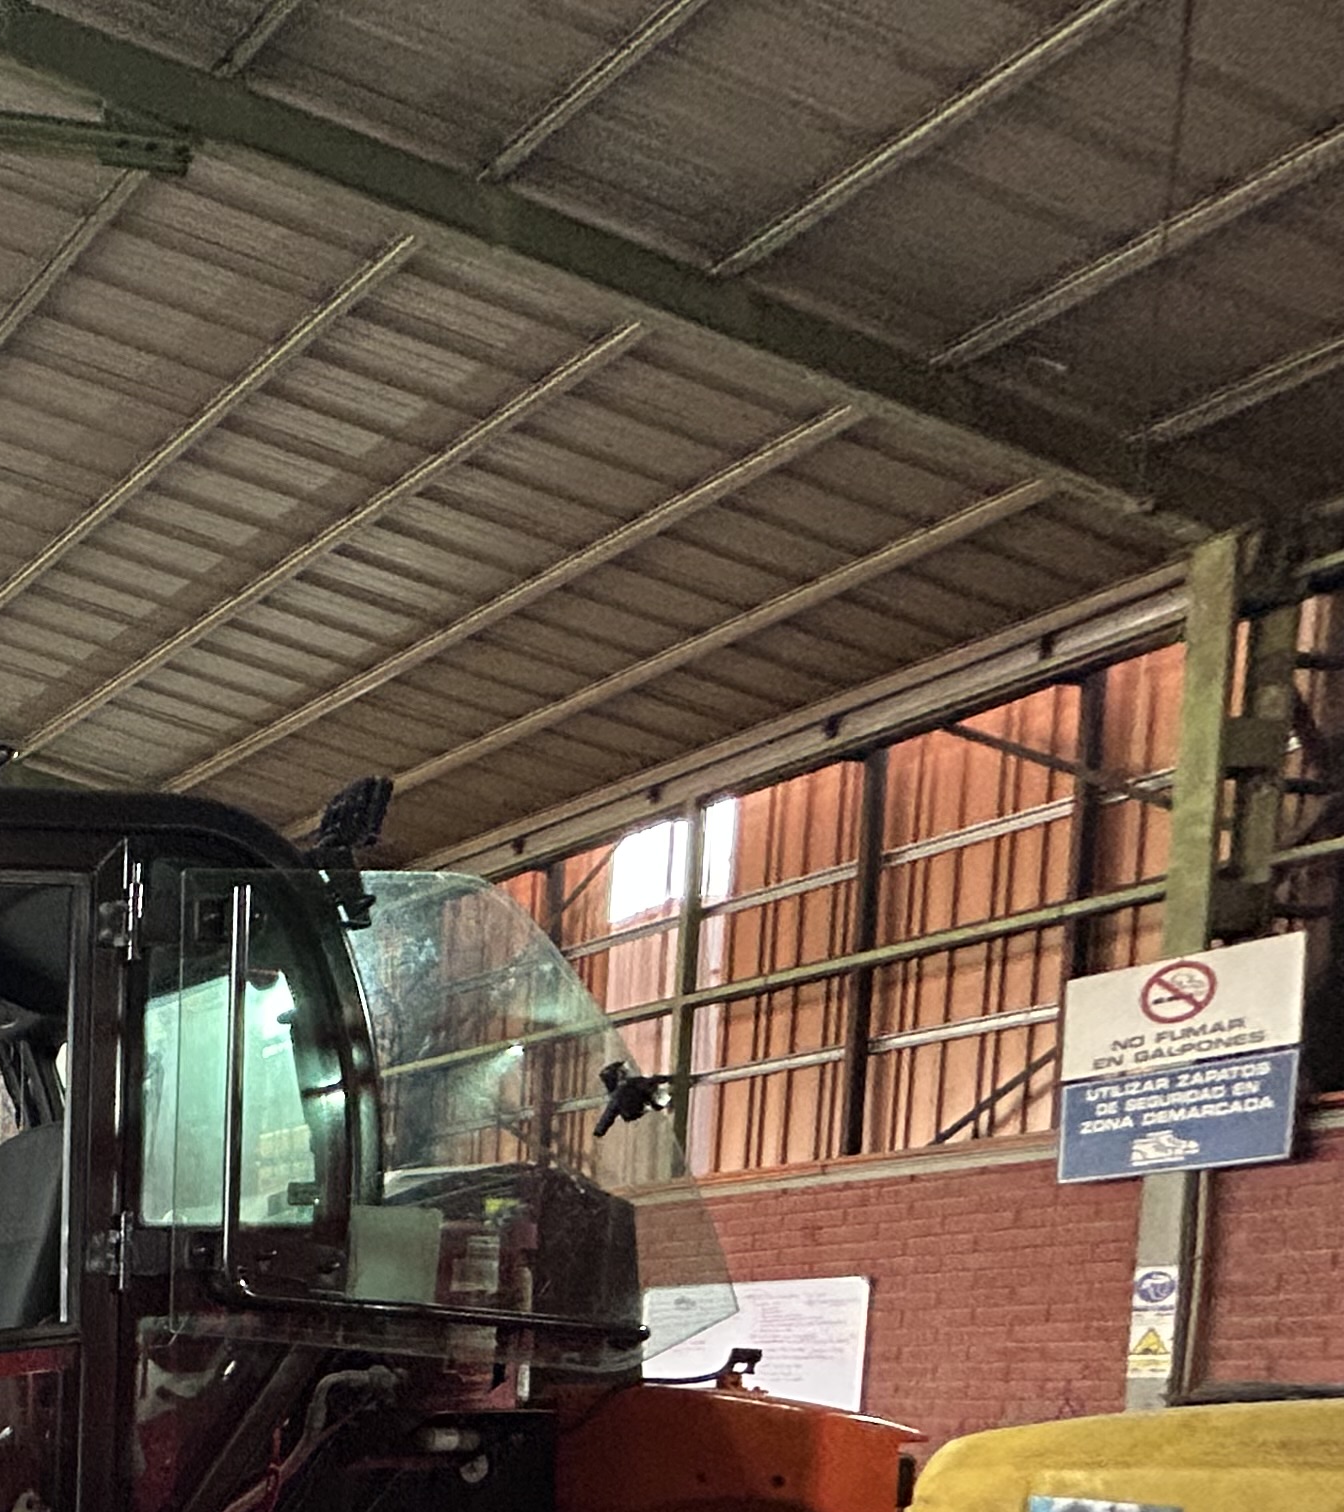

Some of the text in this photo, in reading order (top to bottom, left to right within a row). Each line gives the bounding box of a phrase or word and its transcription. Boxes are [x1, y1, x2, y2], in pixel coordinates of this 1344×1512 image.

[1093, 1030, 1266, 1070] EN GALPONES
[1112, 1017, 1247, 1051] NO FUMAR
[1086, 1062, 1271, 1101] UTILIZAR ZAPATOS
[1095, 1080, 1261, 1117] DE SEGURIDAD EN
[1080, 1096, 1275, 1134] ZONA DEMARCADA
